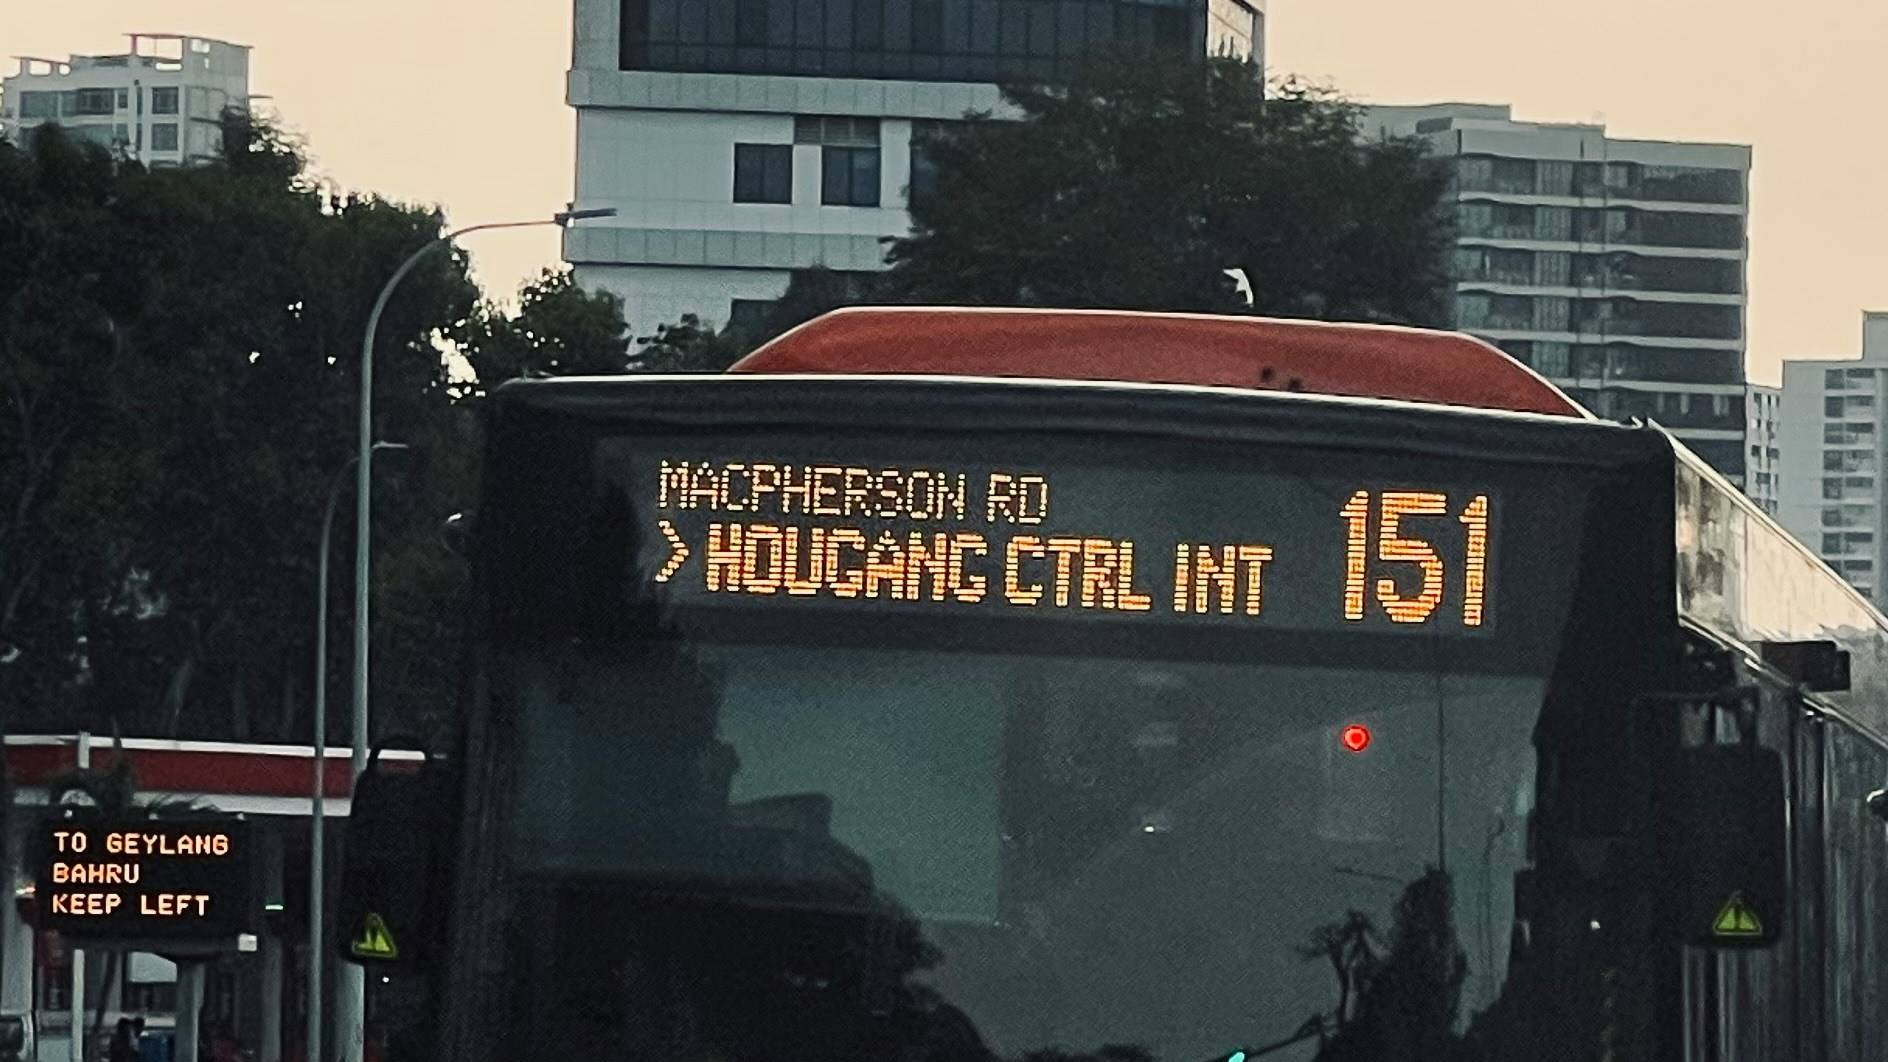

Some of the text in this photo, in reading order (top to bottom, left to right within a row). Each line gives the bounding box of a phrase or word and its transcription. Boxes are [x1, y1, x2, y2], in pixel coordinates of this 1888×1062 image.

[659, 460, 1050, 525] MACPHERSON RD
[705, 521, 1274, 617] HOUGANG CTRL INT
[1339, 489, 1491, 628] 151
[53, 831, 229, 856] TO GEYLANG
[52, 862, 140, 885] BAHRU
[52, 893, 210, 917] KEEP LEFT
